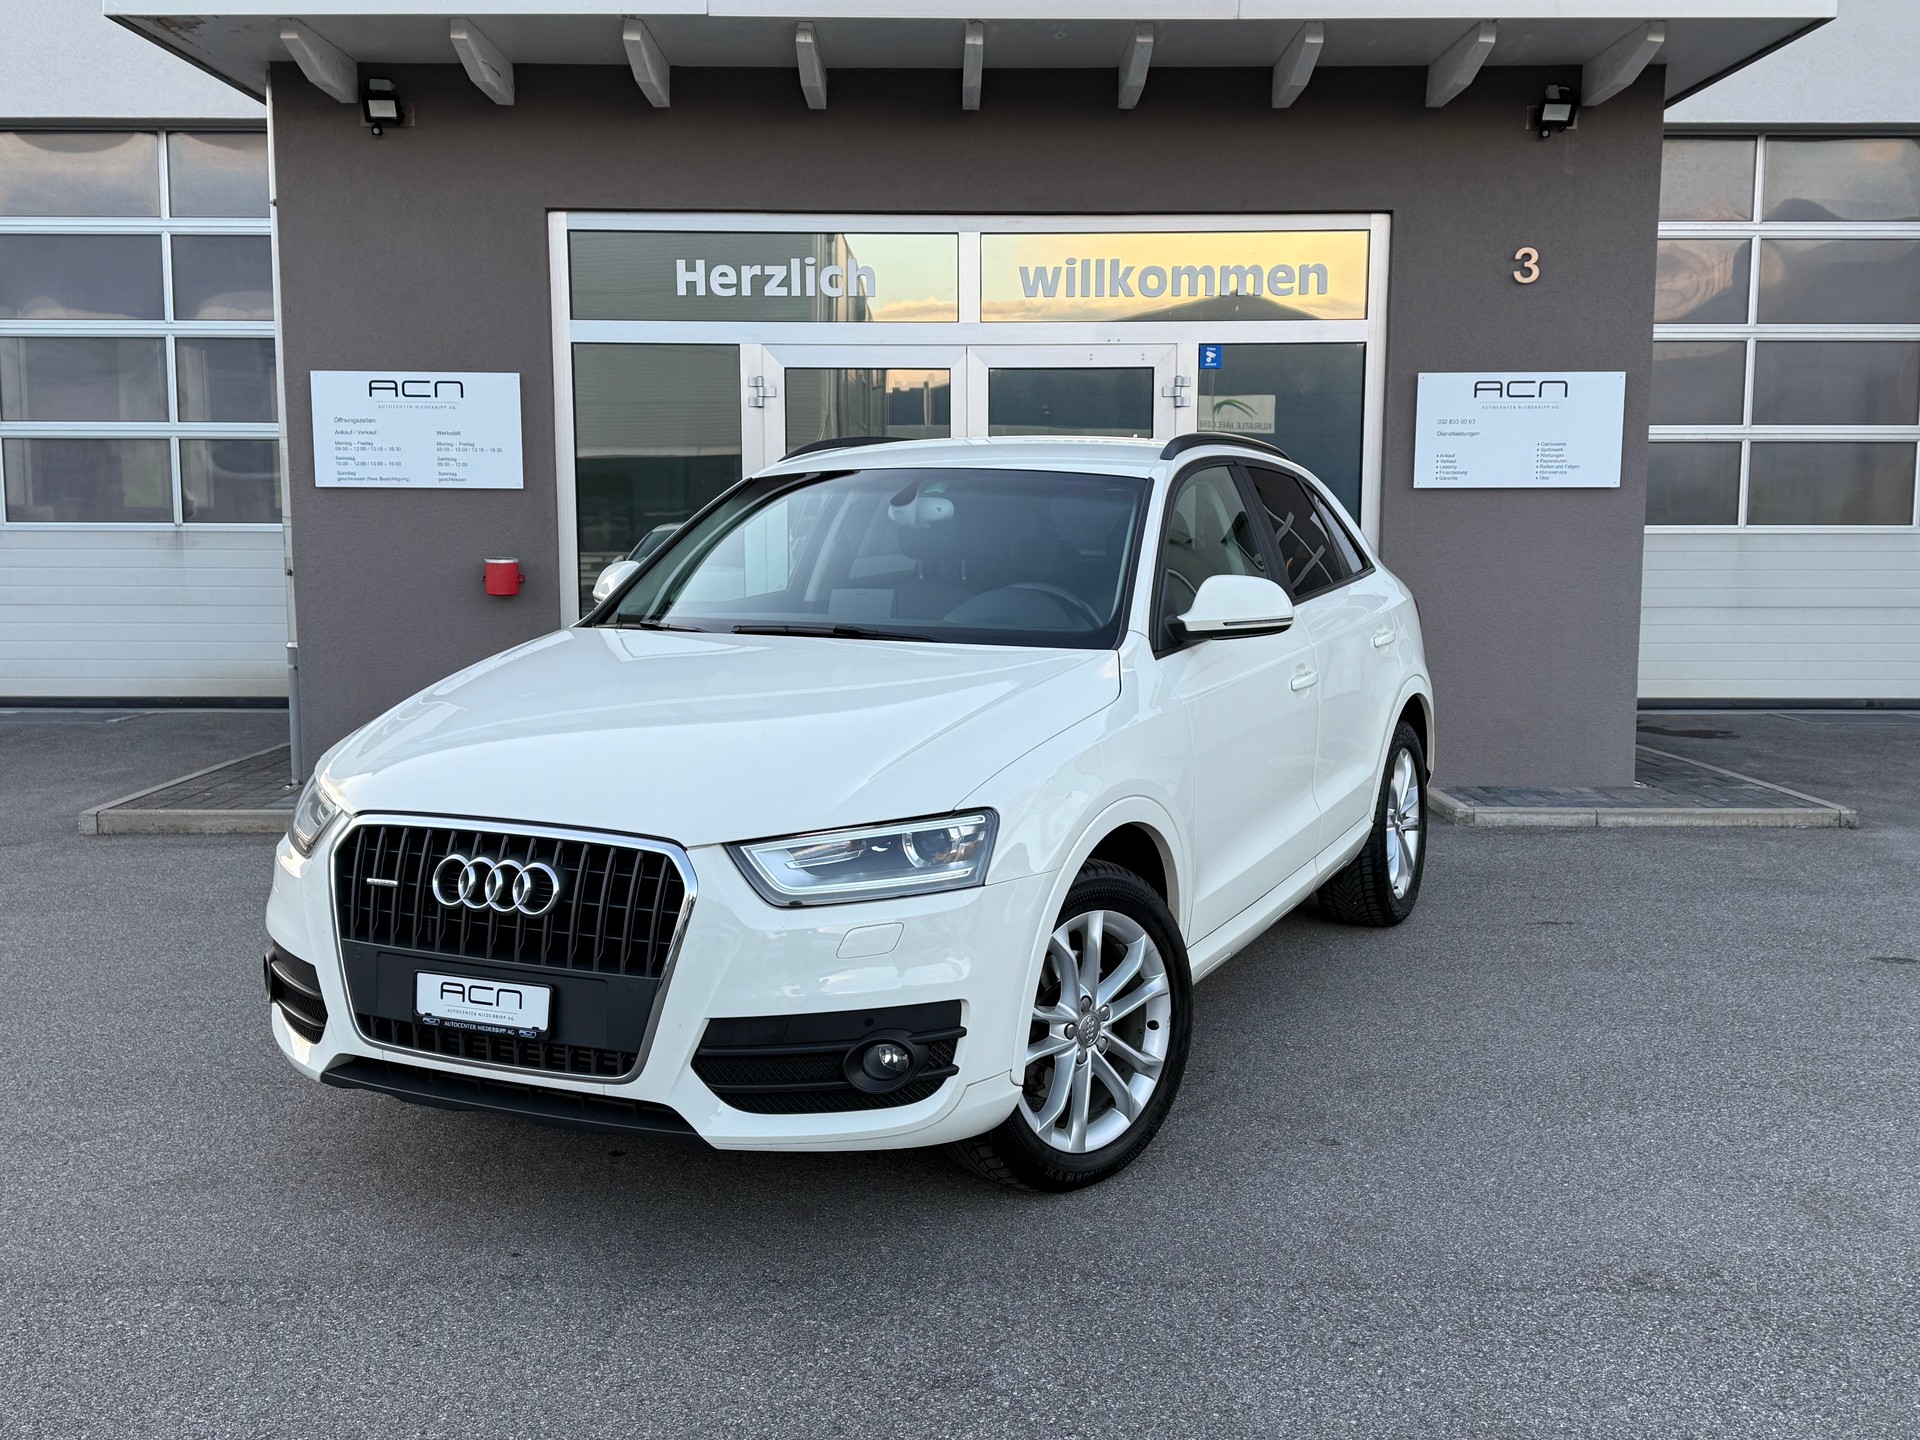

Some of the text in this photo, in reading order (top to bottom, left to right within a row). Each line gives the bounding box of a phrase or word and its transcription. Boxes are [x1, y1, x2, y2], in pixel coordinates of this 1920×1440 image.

[1514, 246, 1540, 284] 3
[676, 258, 1328, 298] Herzlich willkommen
[368, 380, 464, 398] ACN
[1474, 380, 1568, 398] ACN
[440, 982, 522, 1010] ACN
[447, 1009, 477, 1017] AUTOCENTER
[478, 1012, 507, 1020] NIEDERBIPP
[444, 1021, 476, 1031] AUTOCENTER
[477, 1024, 507, 1034] NIEDERBIPP
